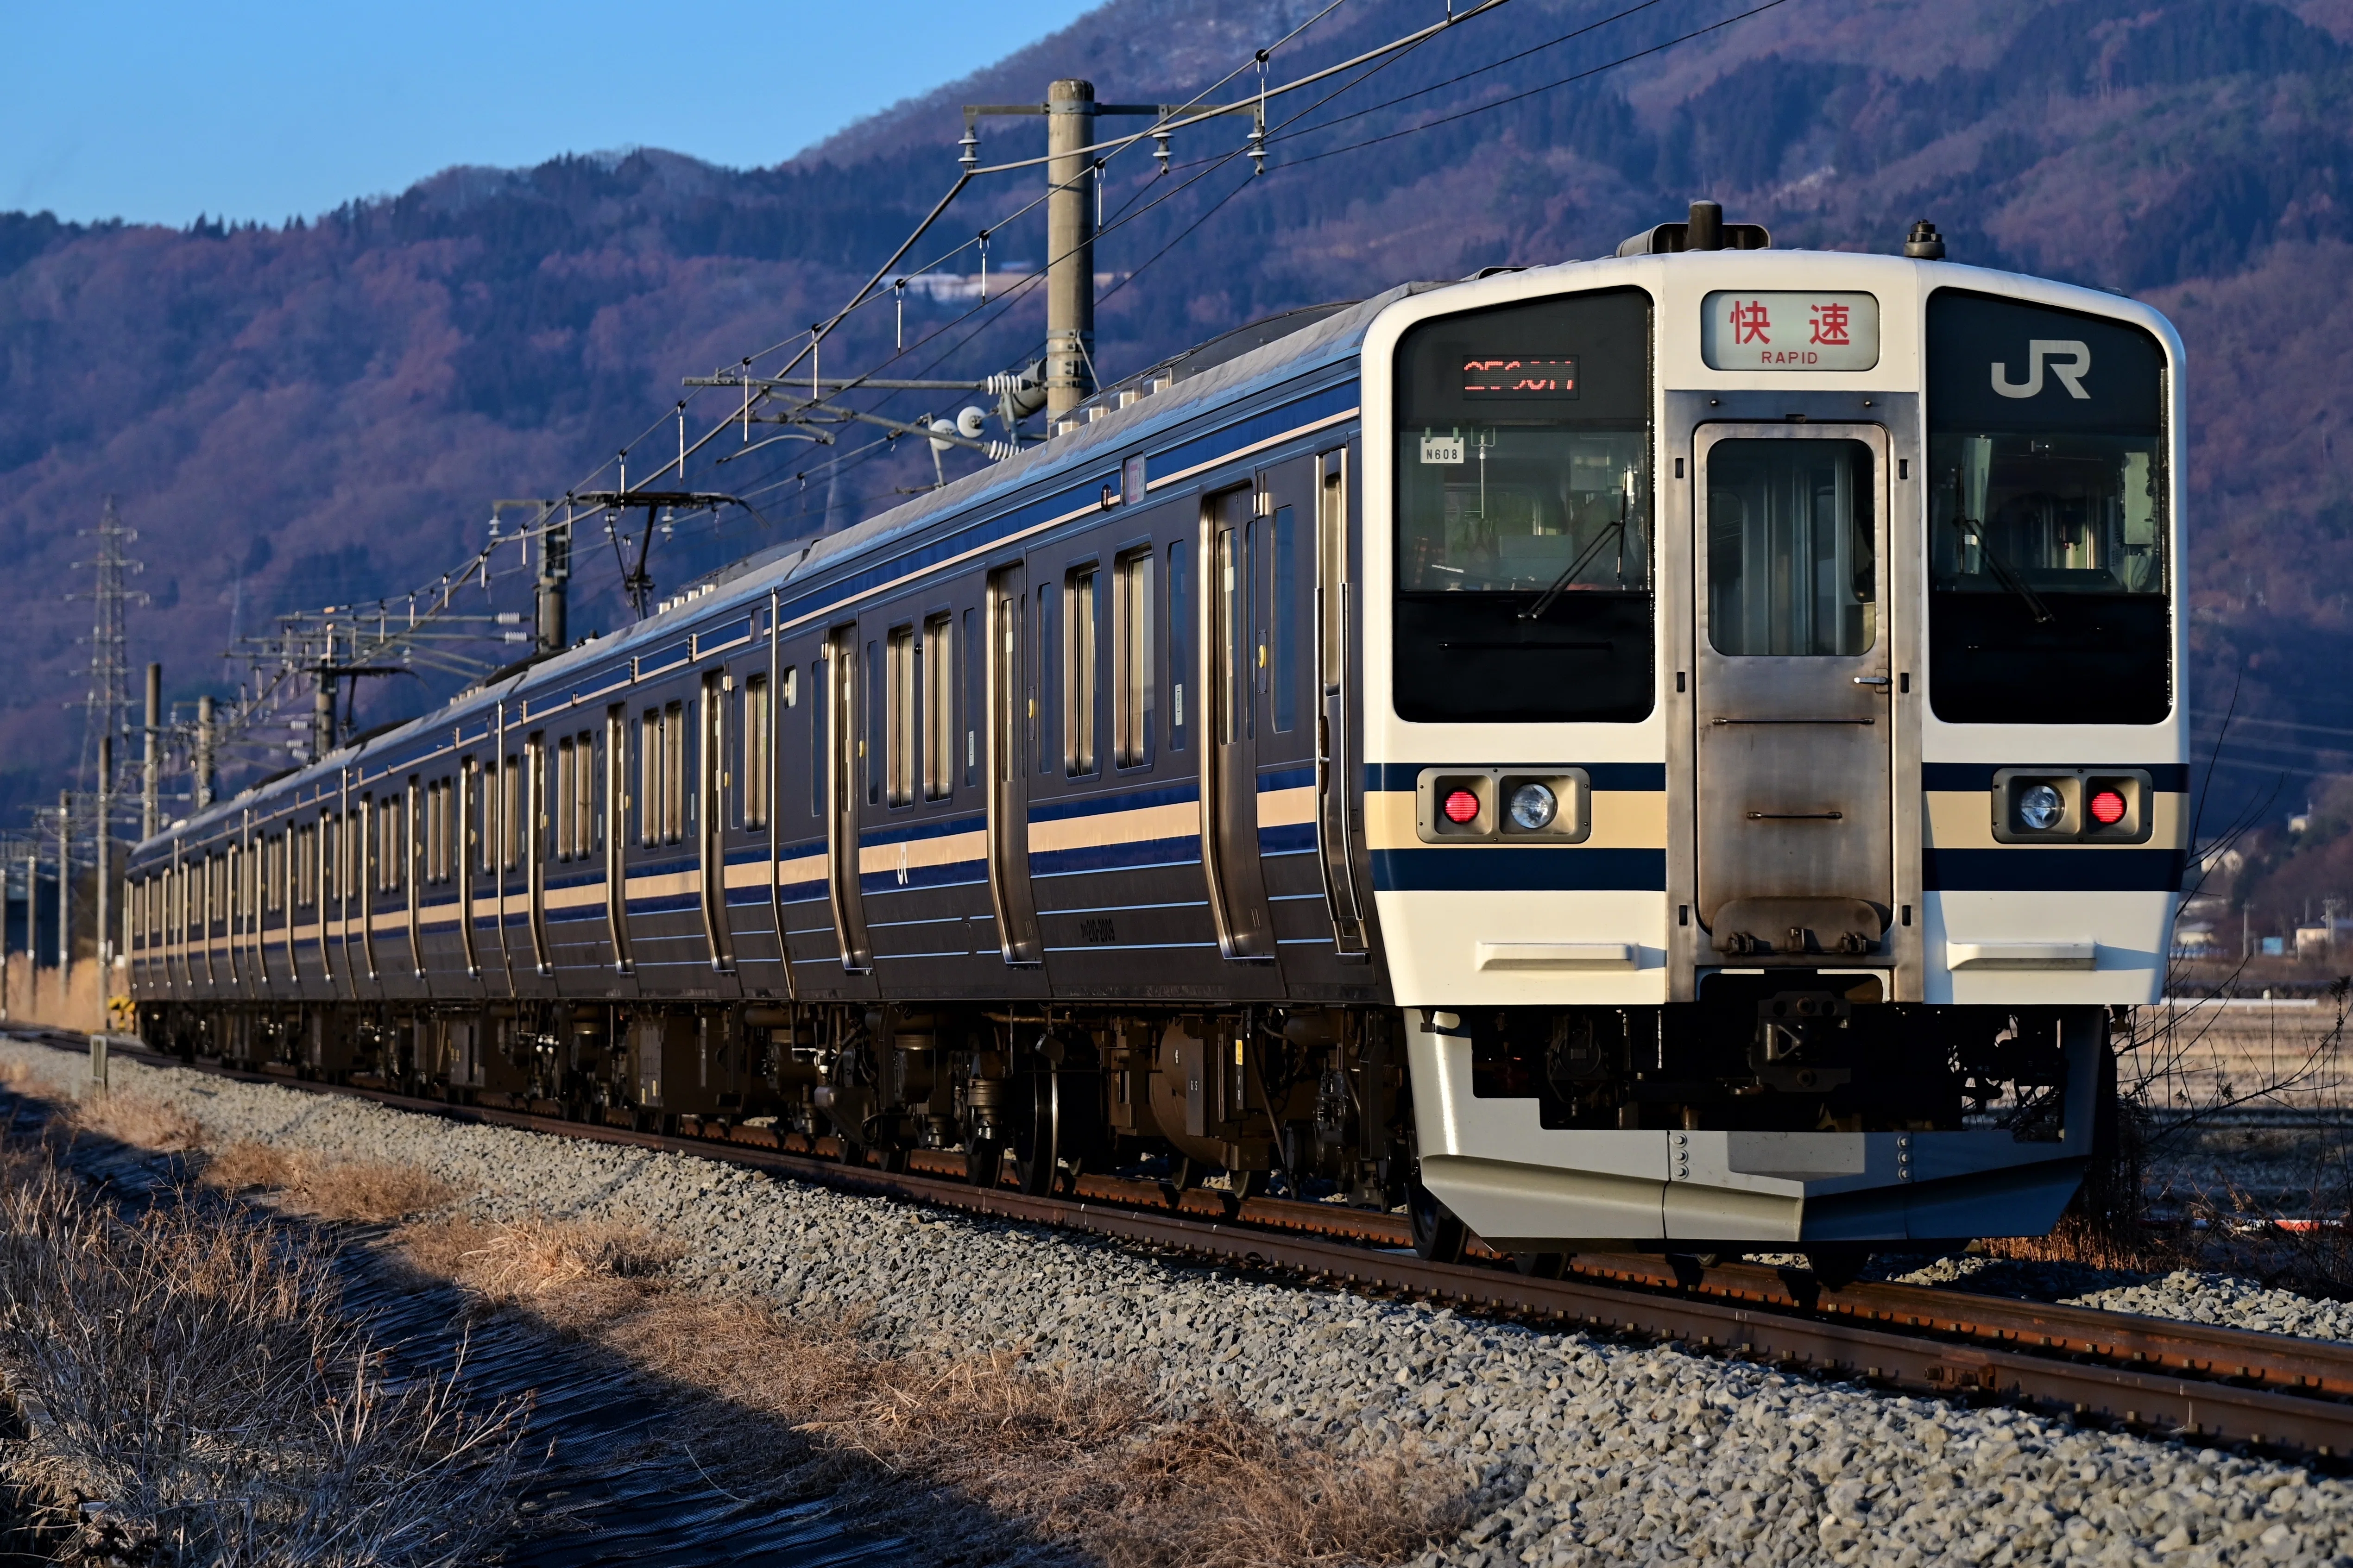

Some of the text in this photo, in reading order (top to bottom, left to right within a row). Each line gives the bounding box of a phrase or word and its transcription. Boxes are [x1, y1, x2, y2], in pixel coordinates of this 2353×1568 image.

[1729, 300, 1849, 345] 快速
[1761, 352, 1818, 364] RAPID
[1991, 340, 2091, 399] JR
[1426, 449, 1458, 460] N608
[897, 843, 908, 885] JR
